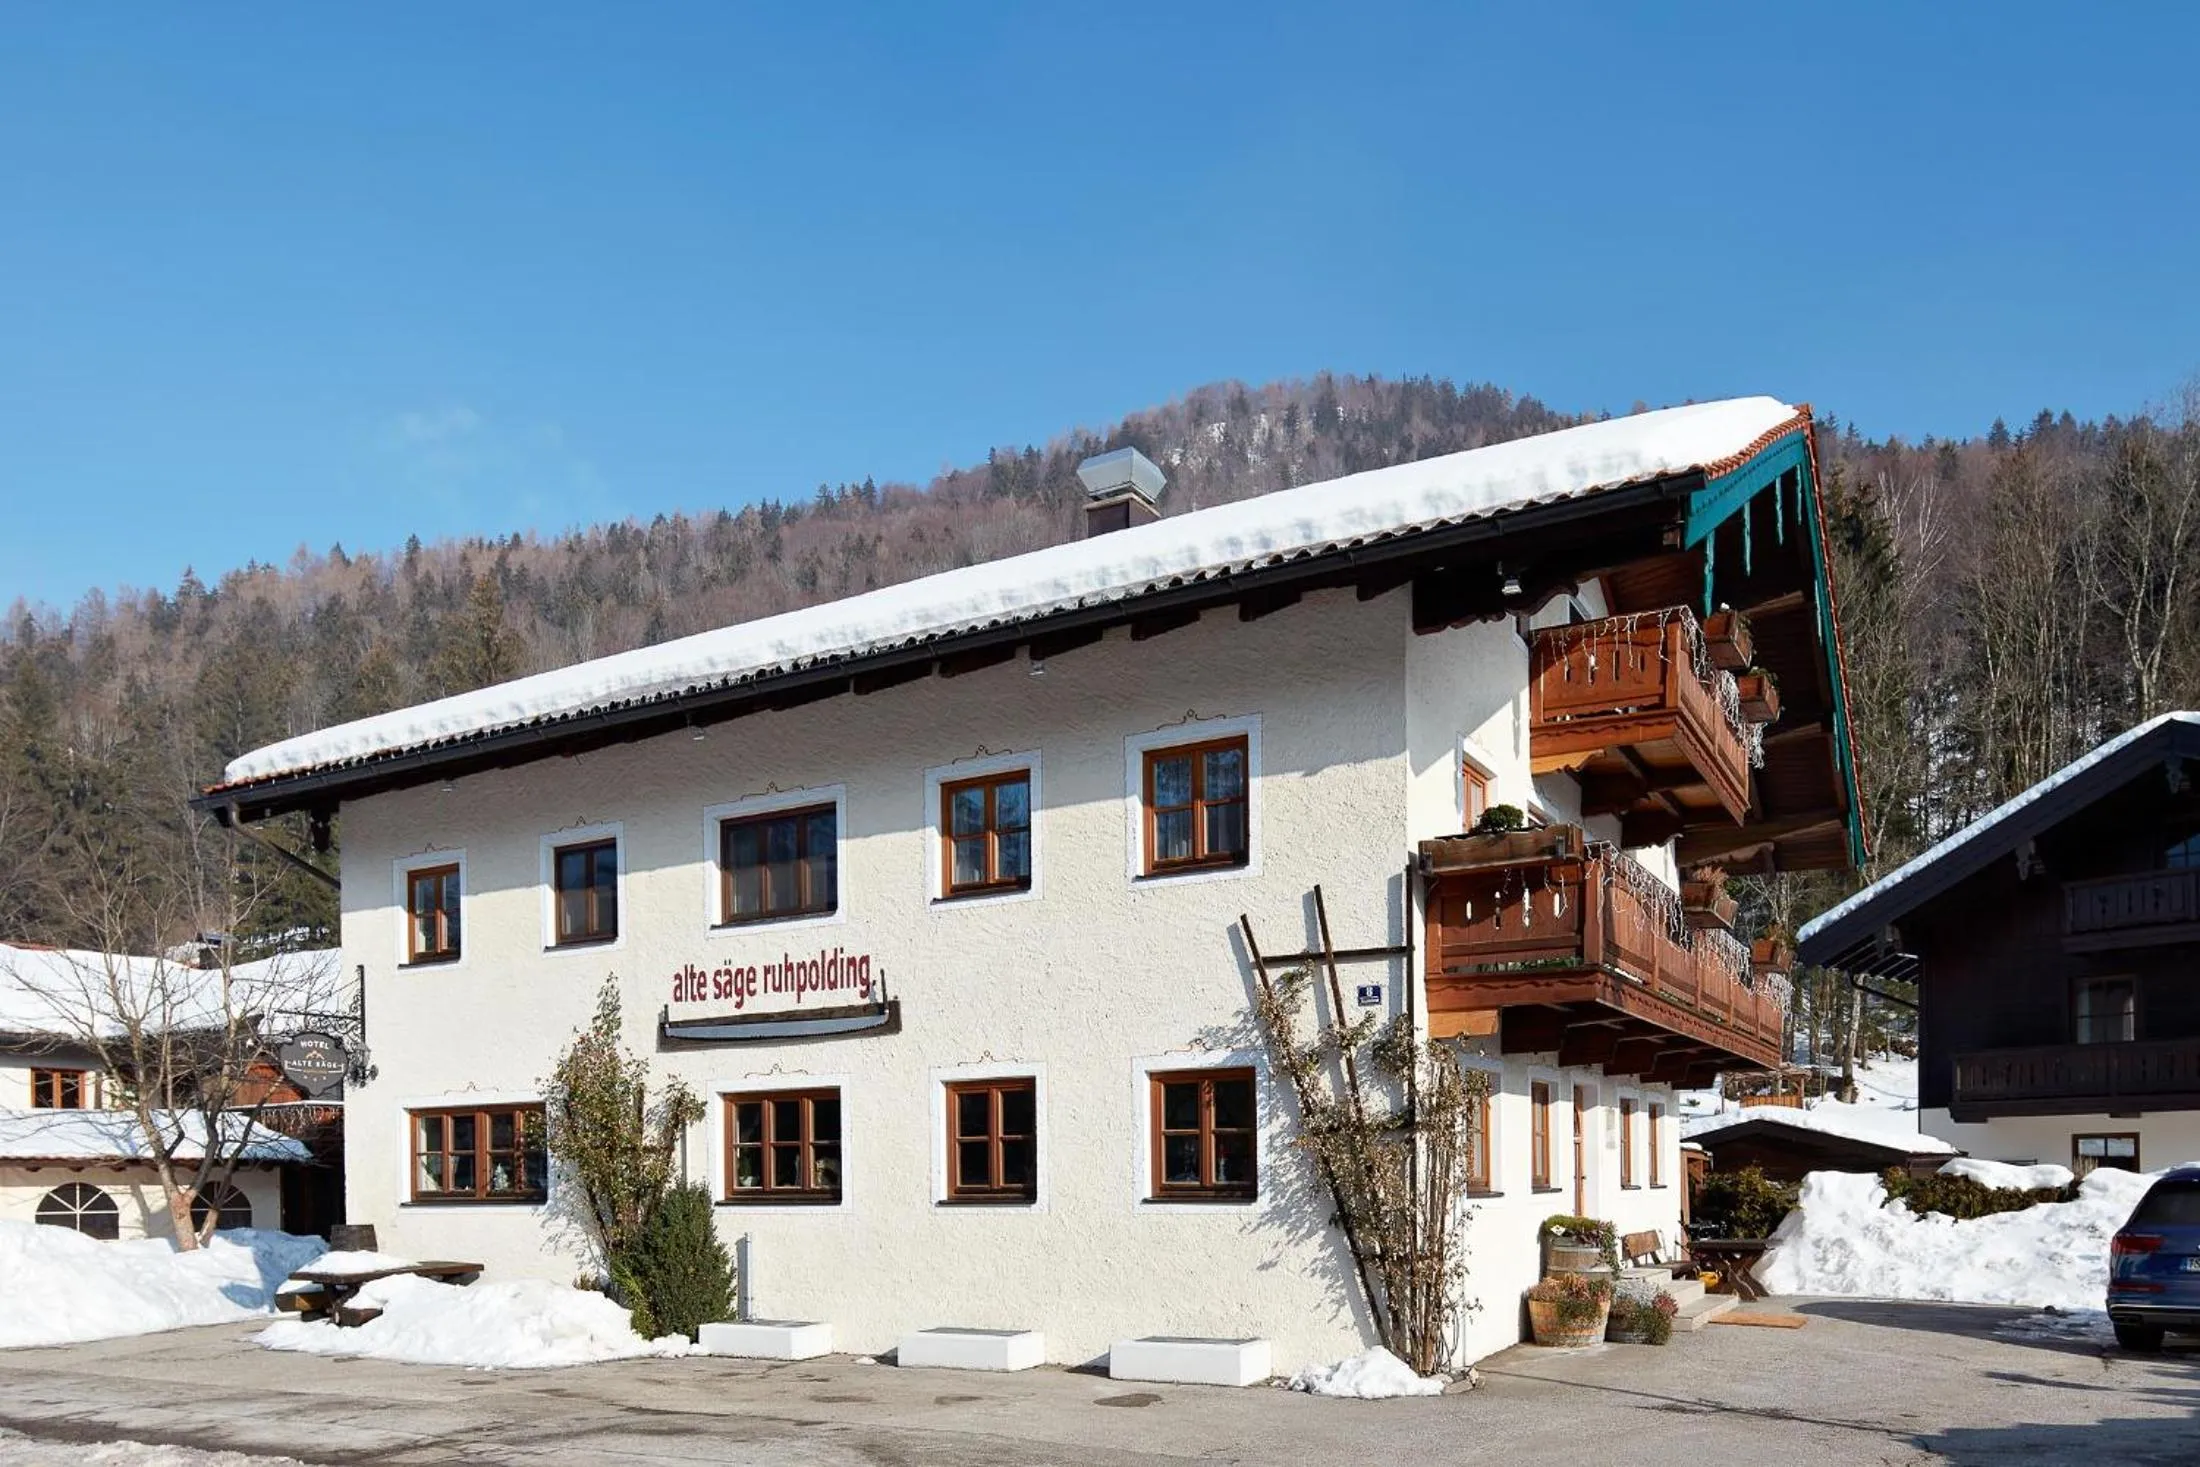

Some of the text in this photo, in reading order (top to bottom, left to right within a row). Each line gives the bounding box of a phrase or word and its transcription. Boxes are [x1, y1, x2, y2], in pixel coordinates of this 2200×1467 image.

[673, 947, 871, 1009] alte säge ruhpolding
[300, 1040, 328, 1050] HOTEL
